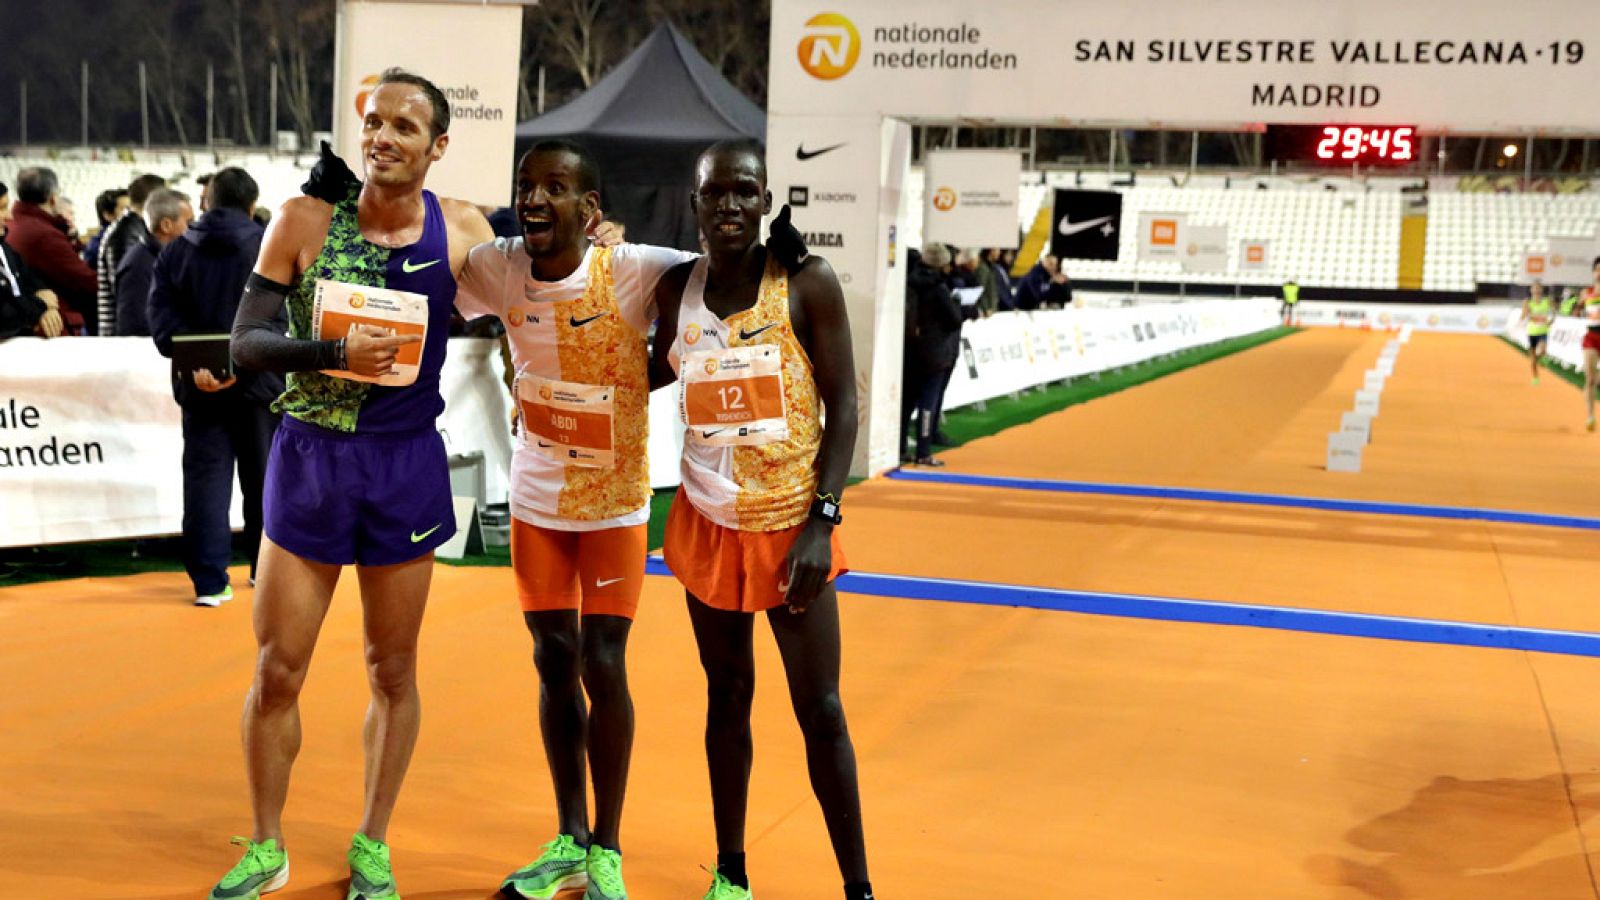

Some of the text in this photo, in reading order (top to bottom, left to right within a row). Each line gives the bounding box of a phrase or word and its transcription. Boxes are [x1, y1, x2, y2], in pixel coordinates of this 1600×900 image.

[874, 22, 980, 44] nationale
[873, 48, 1017, 69] nederlanden
[1074, 40, 1135, 63] SAN
[1147, 40, 1315, 63] SILVESTRE
[1252, 84, 1380, 107] MADRID
[450, 102, 503, 121] landen
[1316, 126, 1412, 161] 29:45
[525, 314, 540, 324] NN
[718, 385, 745, 410] 12
[551, 413, 578, 431] ABDI
